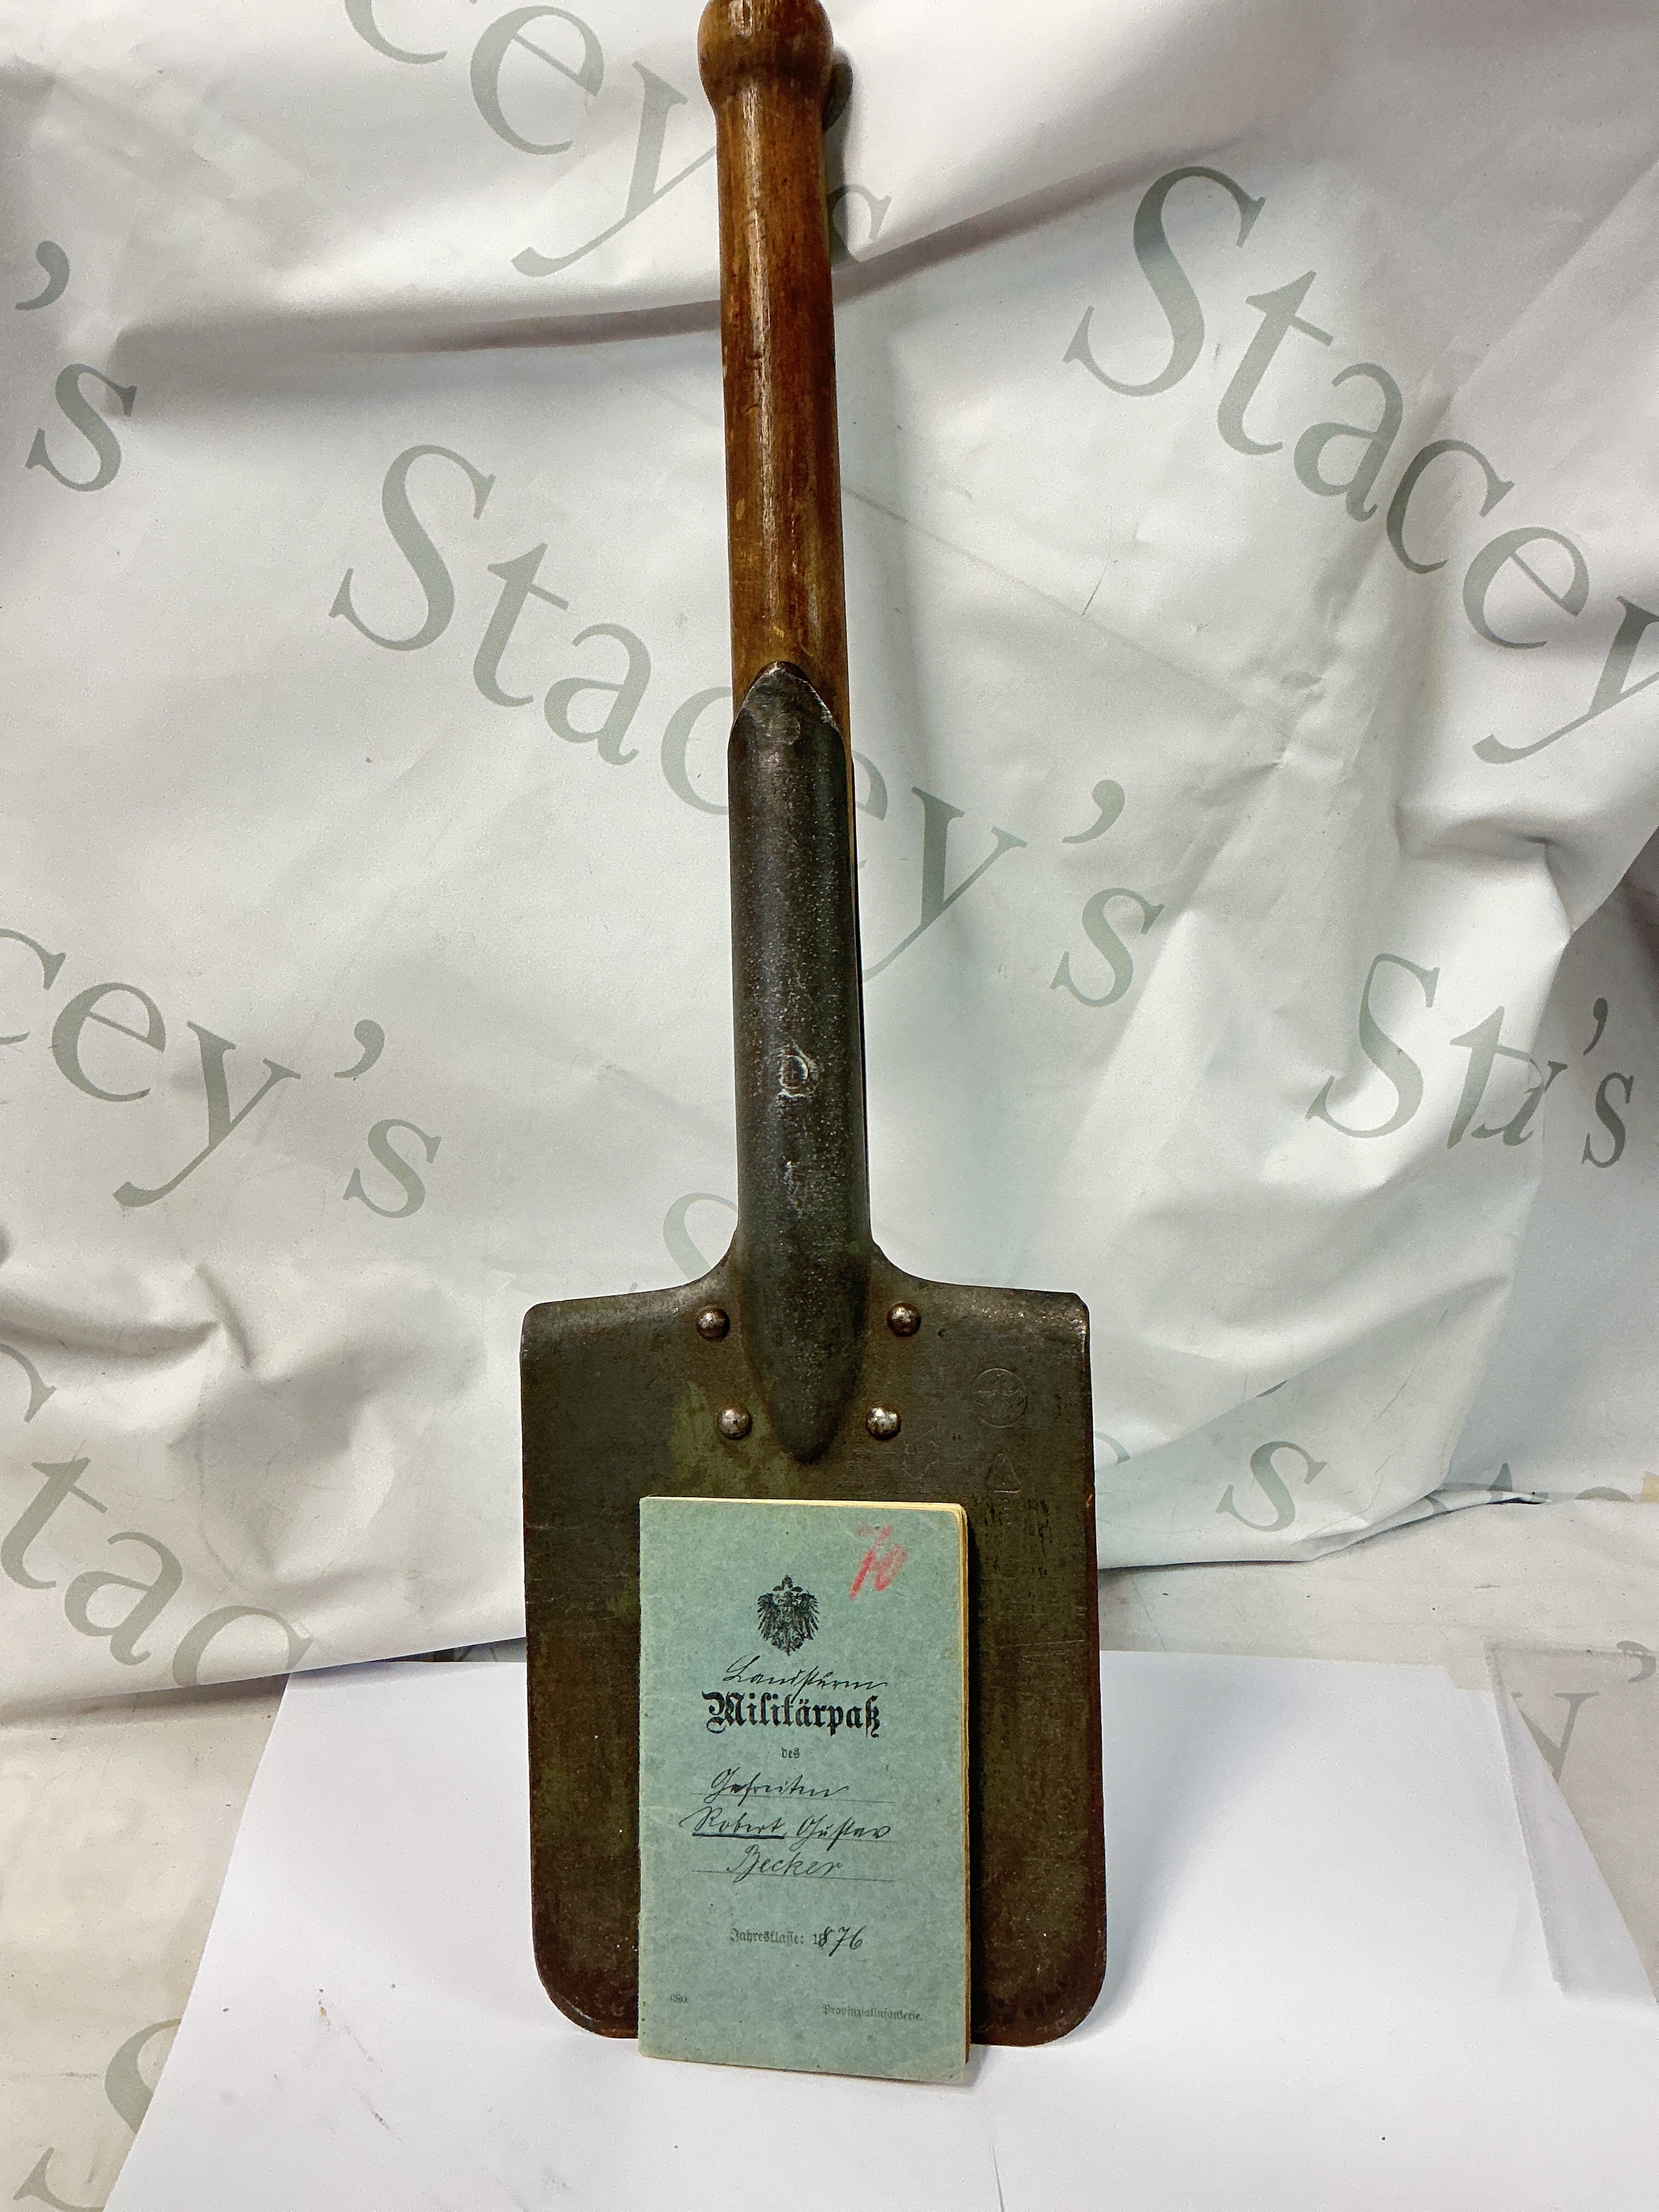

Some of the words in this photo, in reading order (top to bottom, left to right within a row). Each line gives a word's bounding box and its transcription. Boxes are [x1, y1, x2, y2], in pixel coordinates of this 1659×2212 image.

[701, 1691, 881, 1738] Militärpaß
[780, 1745, 800, 1759] des
[726, 1844, 842, 1883] Becker
